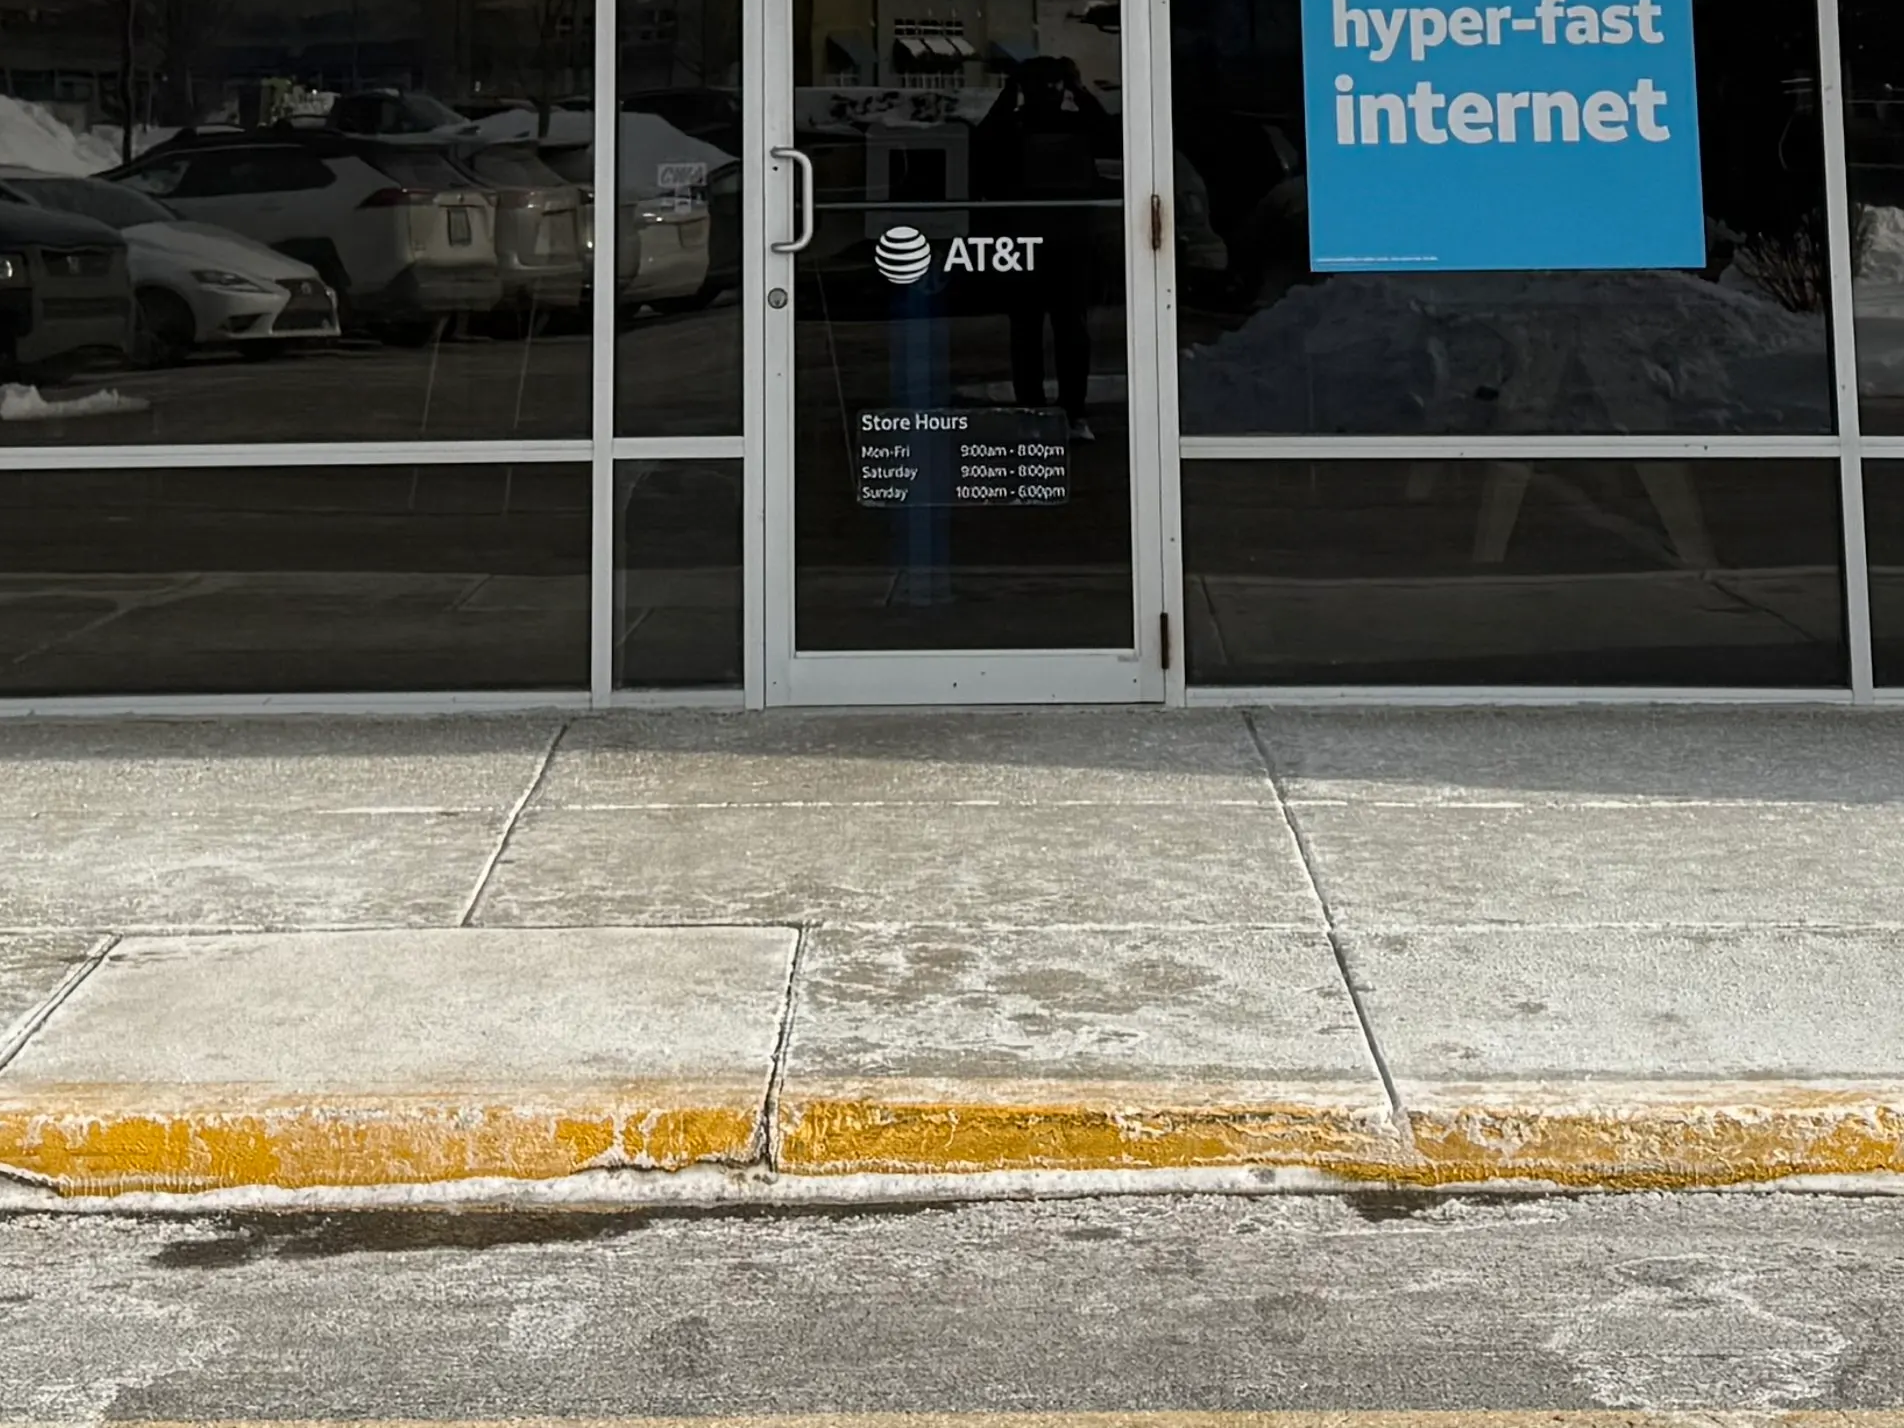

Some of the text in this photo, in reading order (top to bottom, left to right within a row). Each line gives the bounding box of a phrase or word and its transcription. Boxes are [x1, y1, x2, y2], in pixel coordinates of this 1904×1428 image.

[1334, 74, 1671, 145] internet
[943, 236, 1044, 273] AT&T
[861, 413, 969, 432] Store Hours
[861, 445, 911, 459] Mon-Fri
[960, 444, 1007, 458] 9:00am
[1017, 444, 1065, 460] 8:00pm
[861, 465, 919, 481] Saturday
[960, 465, 1007, 478] 9:00am
[1017, 464, 1065, 480] 8:00pm
[862, 486, 909, 501] Sunday
[955, 486, 1008, 499] 10:00am
[1017, 485, 1066, 501] 6:00pm
